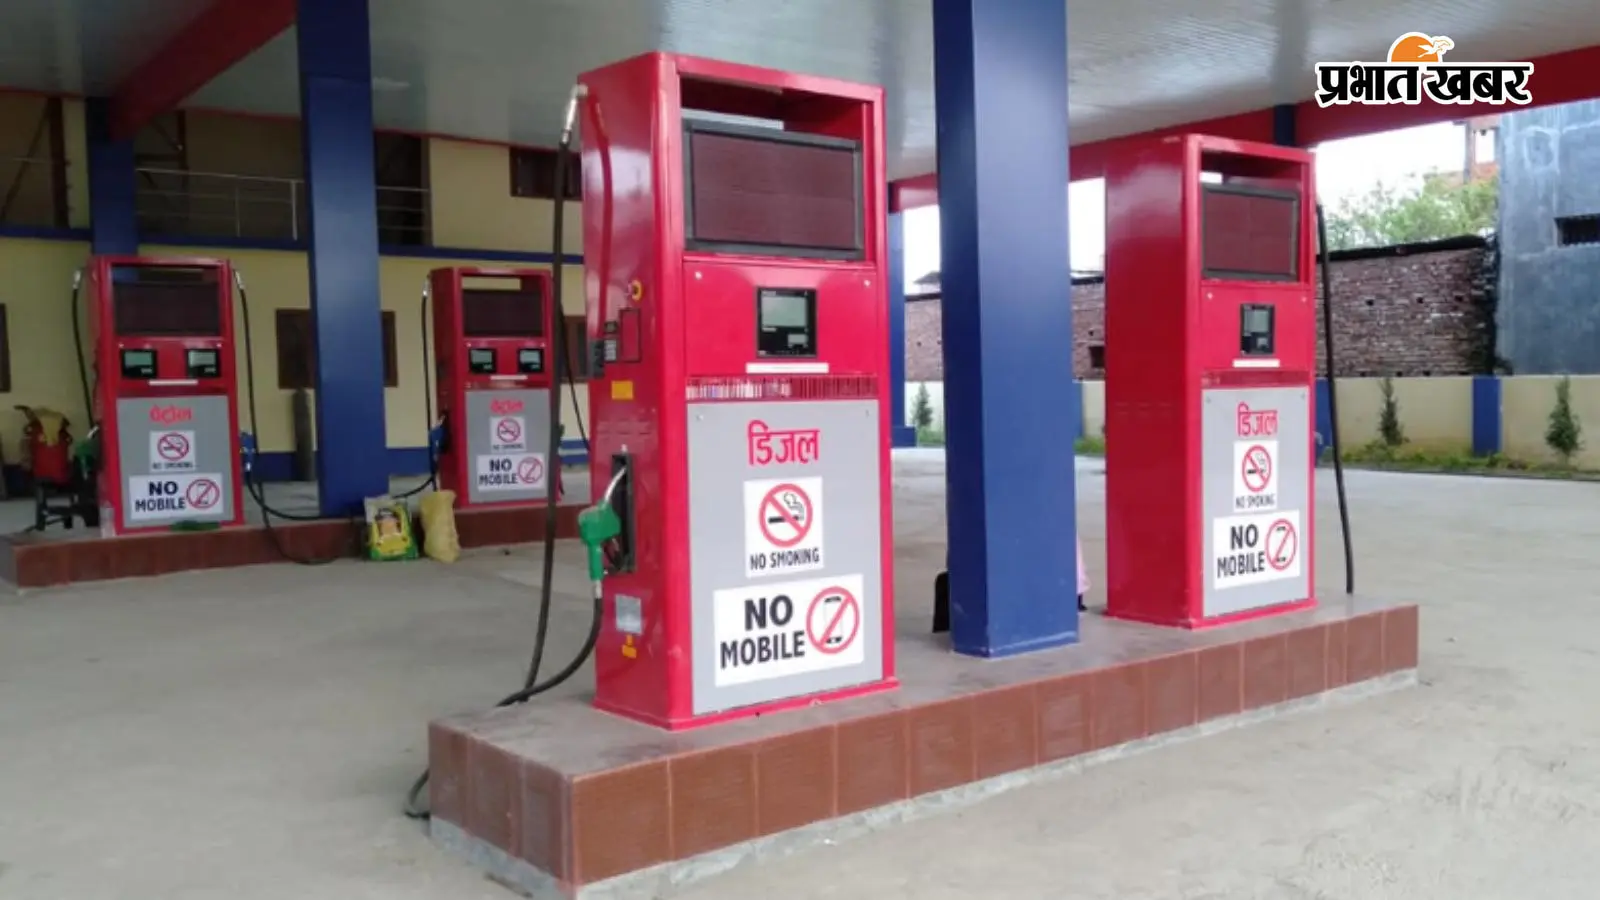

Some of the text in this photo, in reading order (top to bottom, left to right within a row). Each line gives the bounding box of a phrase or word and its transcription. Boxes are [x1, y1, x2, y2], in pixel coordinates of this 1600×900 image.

[1237, 402, 1278, 437] डिजल
[747, 419, 820, 466] डिजल
[489, 459, 512, 472] NO
[149, 481, 179, 496] NO
[479, 474, 518, 485] MOBILE
[135, 498, 186, 512] MOBILE
[1235, 494, 1275, 508] NO SMOKING
[1230, 524, 1258, 550] NO
[750, 548, 820, 570] NO SMOKING
[1217, 551, 1265, 578] MOBILE
[744, 595, 794, 631] NO
[720, 630, 806, 669] MOBILE
